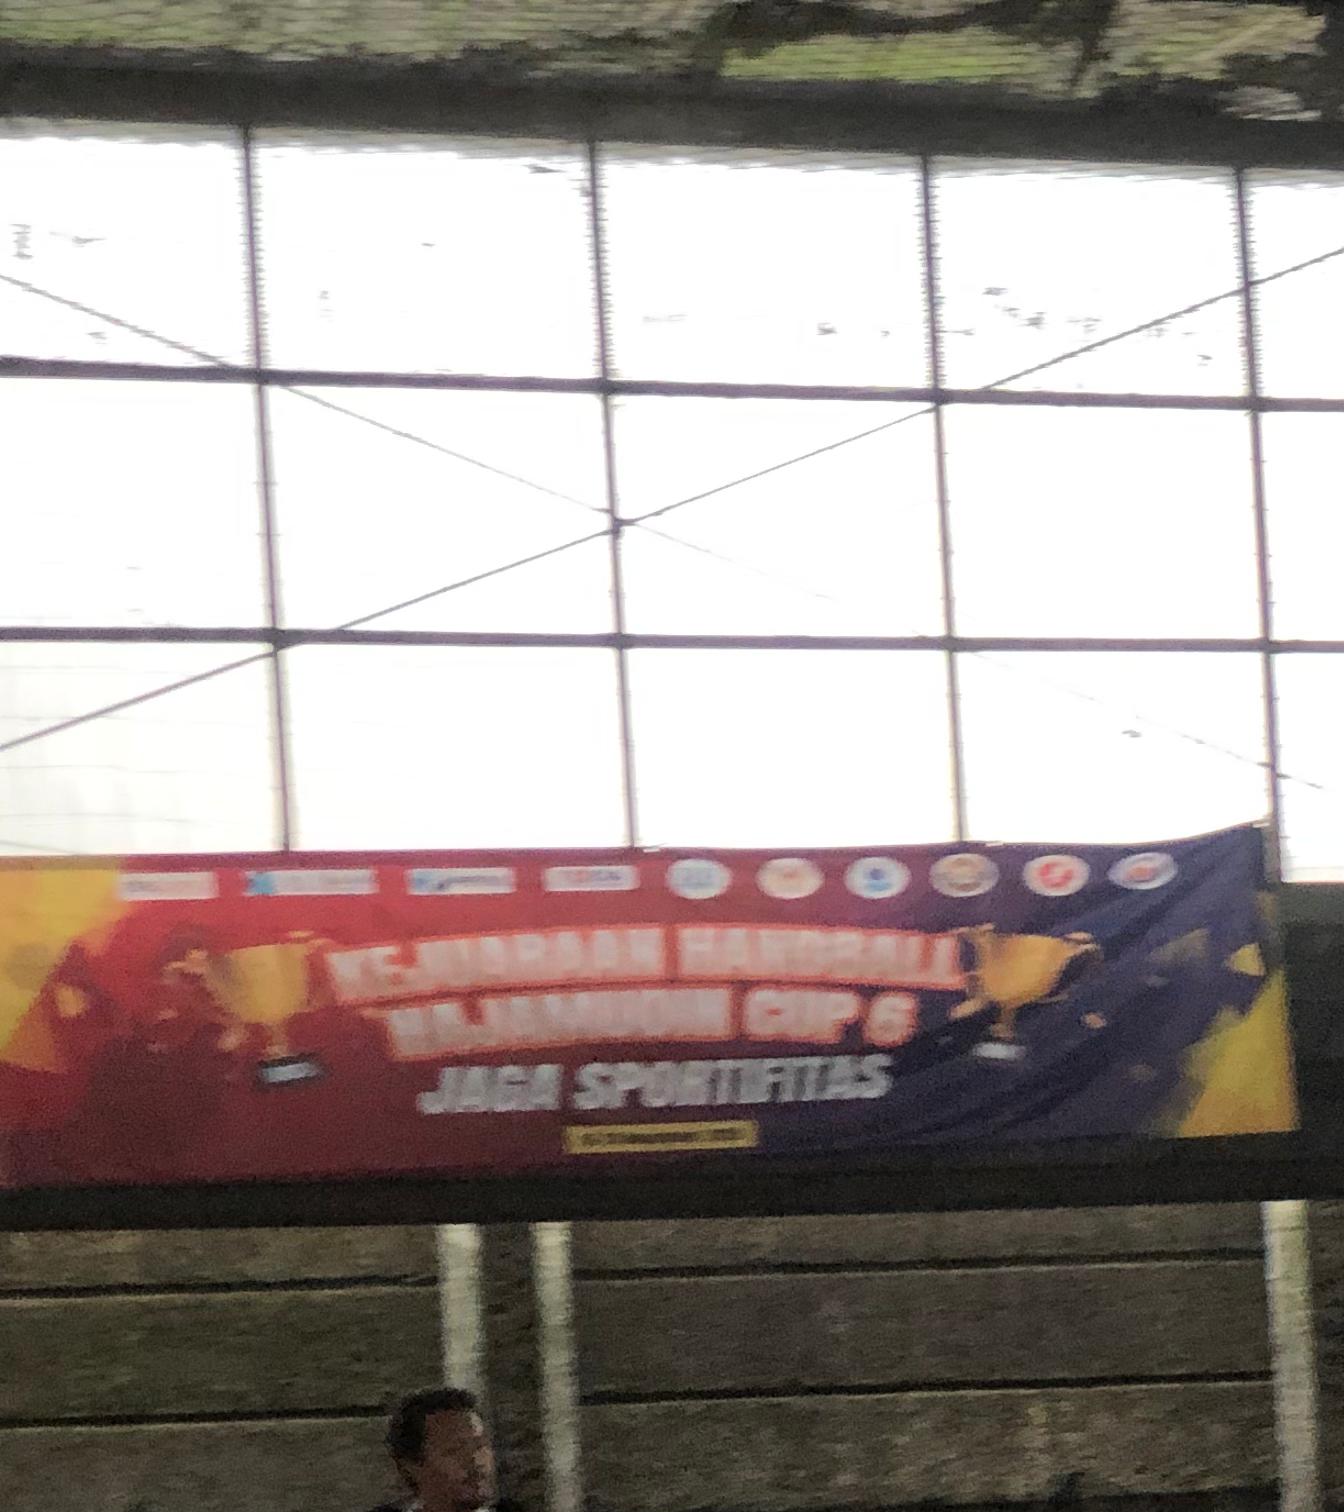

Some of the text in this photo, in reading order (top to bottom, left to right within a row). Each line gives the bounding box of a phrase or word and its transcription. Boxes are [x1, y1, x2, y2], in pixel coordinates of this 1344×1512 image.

[749, 988, 860, 1040] CUP
[417, 1053, 893, 1116] JAGA SPORTIFITAS
